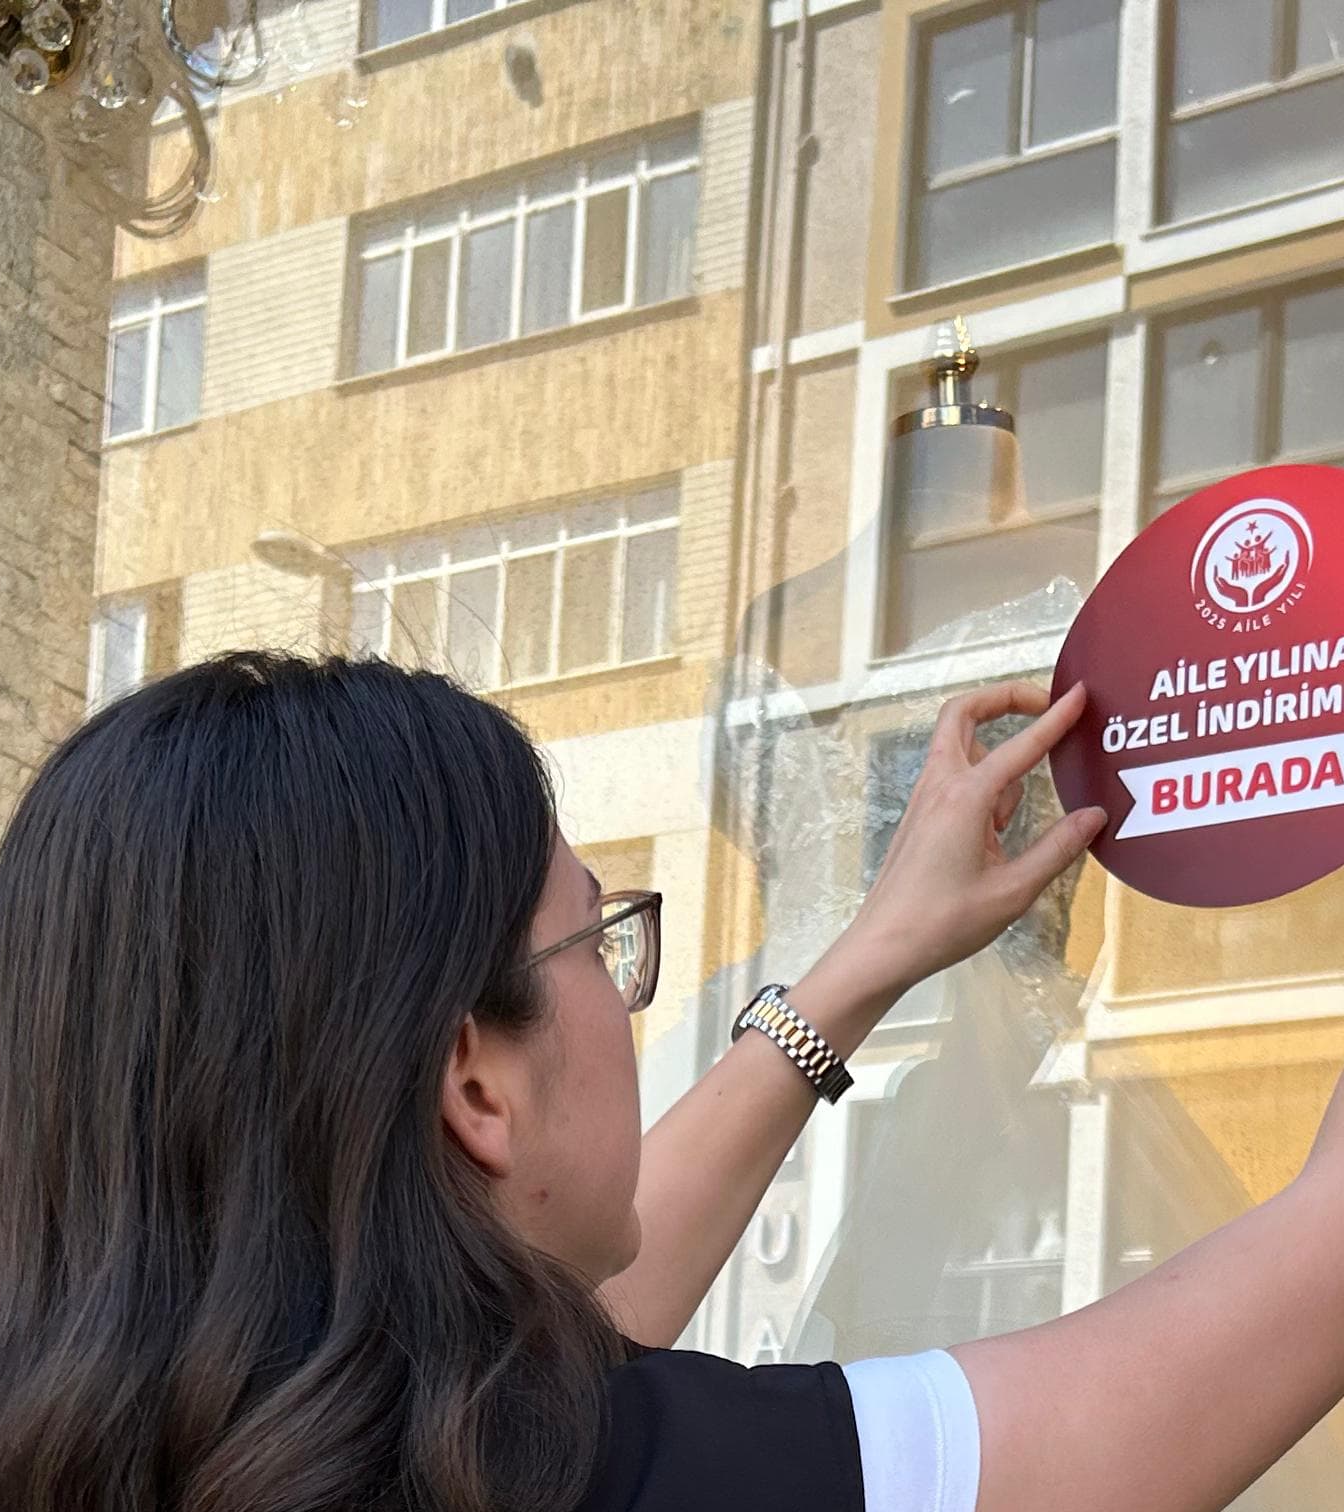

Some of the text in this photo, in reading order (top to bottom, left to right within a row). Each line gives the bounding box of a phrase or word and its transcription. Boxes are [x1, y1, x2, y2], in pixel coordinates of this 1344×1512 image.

[1195, 599, 1226, 630] 2025
[1276, 583, 1306, 614] YILI
[1150, 657, 1227, 701] AİLE
[1102, 712, 1188, 754] ÖZEL
[1151, 751, 1344, 816] BURADA
